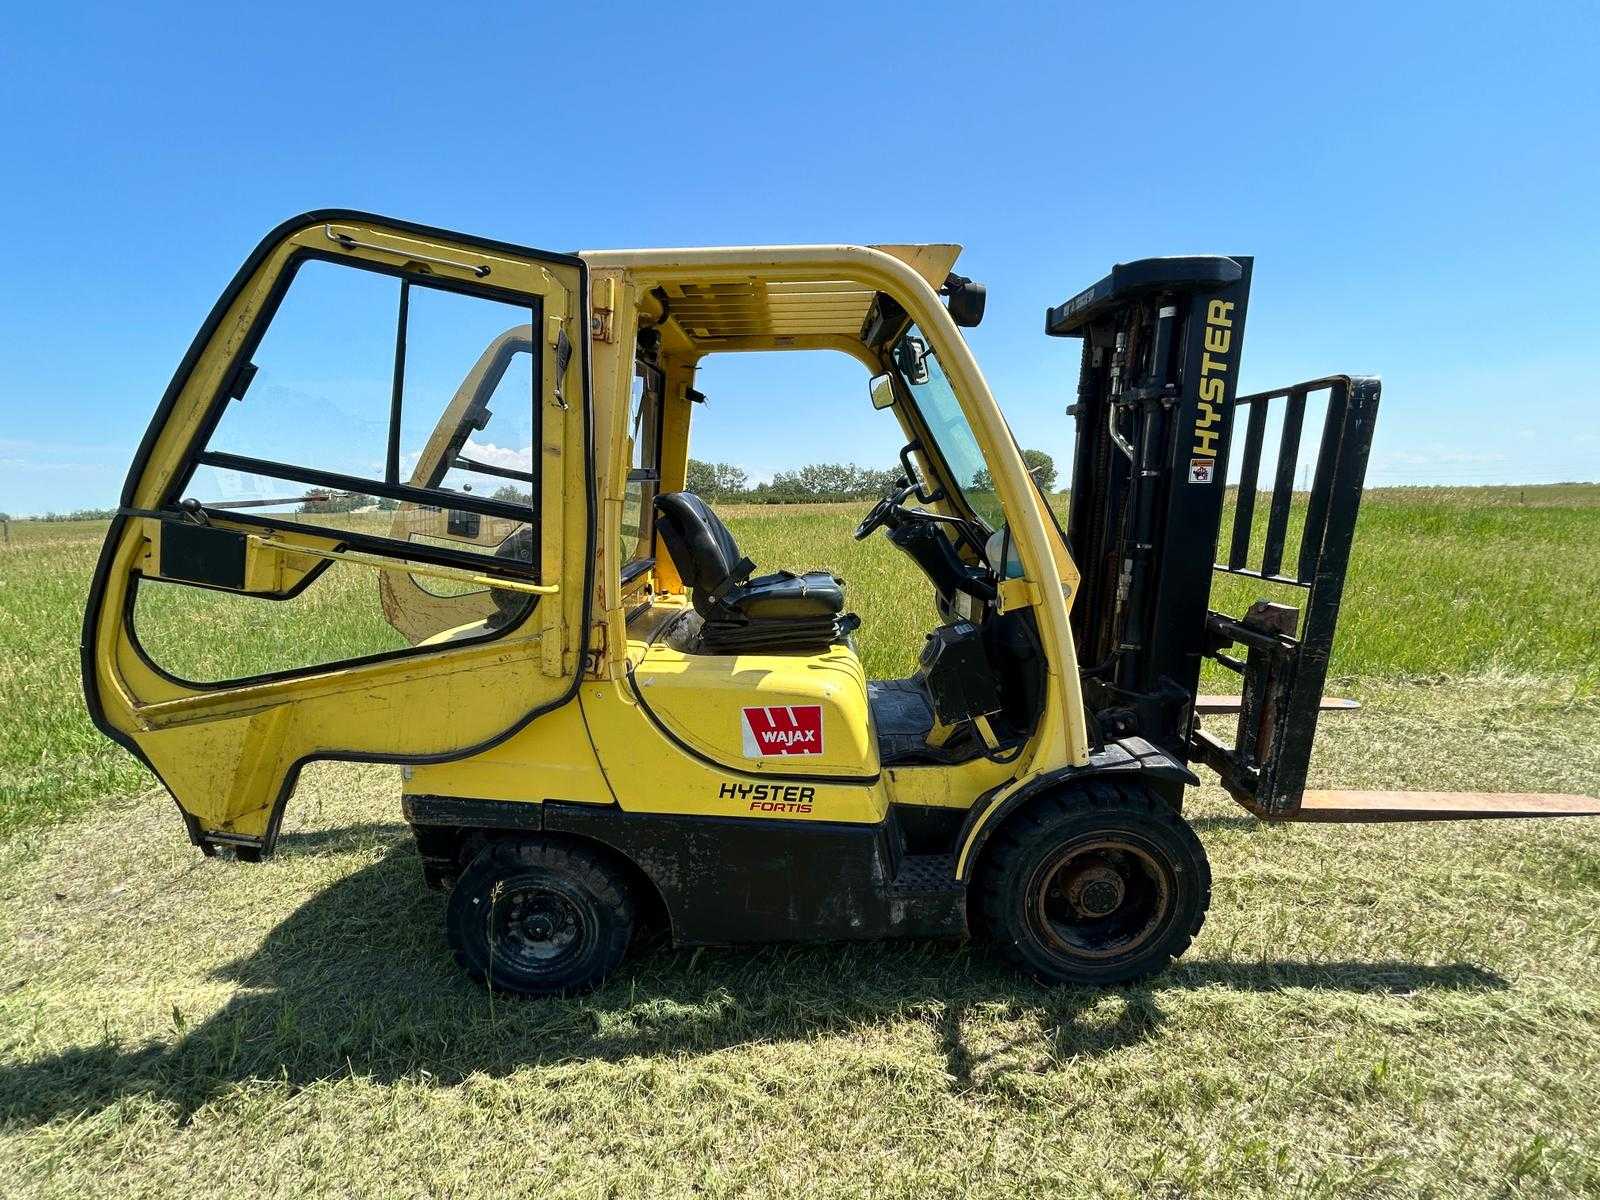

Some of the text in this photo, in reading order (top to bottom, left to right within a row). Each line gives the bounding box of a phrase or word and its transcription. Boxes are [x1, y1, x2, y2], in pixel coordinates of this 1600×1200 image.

[1193, 299, 1234, 457] HYSTER
[761, 730, 815, 746] WAJAX
[719, 783, 815, 802] HYSTER
[749, 801, 812, 813] FORTIS
